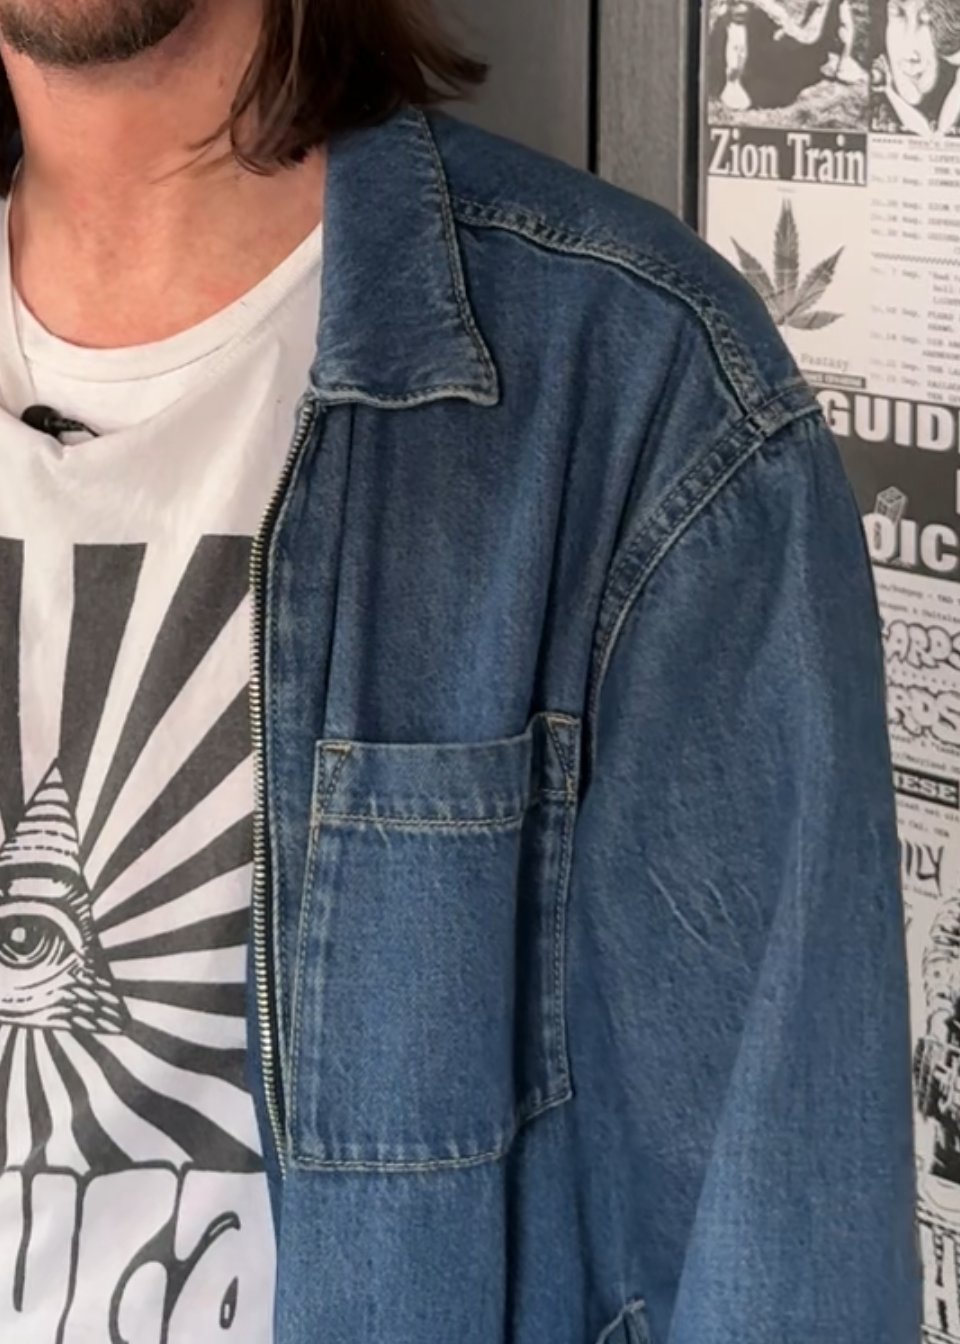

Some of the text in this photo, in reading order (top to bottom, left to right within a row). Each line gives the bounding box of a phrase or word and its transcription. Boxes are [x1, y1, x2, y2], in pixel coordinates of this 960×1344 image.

[708, 127, 866, 187] Zion Train
[815, 389, 960, 452] GUID
